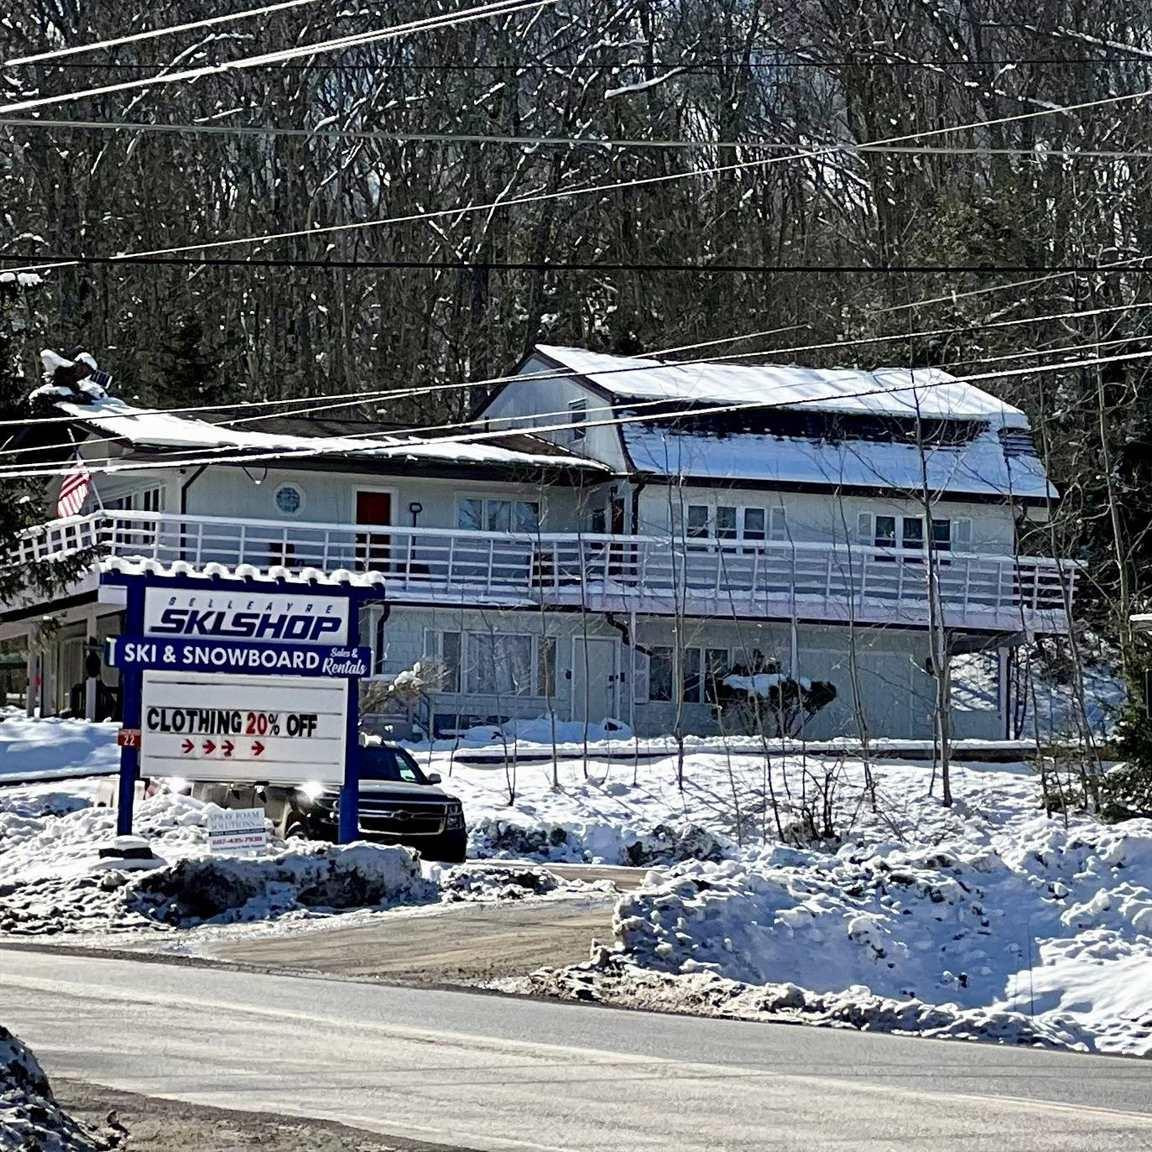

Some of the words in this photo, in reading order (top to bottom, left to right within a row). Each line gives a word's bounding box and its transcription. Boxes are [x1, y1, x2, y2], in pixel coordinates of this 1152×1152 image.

[124, 643, 157, 663] SKI
[163, 645, 177, 663] &
[182, 645, 320, 670] SNOWBOARD
[330, 647, 350, 658] Sales
[351, 647, 359, 658] &
[322, 657, 367, 676] Rentals
[147, 707, 243, 735] CLOTHING
[246, 711, 280, 736] 20%
[286, 713, 318, 737] OFF
[123, 735, 135, 746] 22
